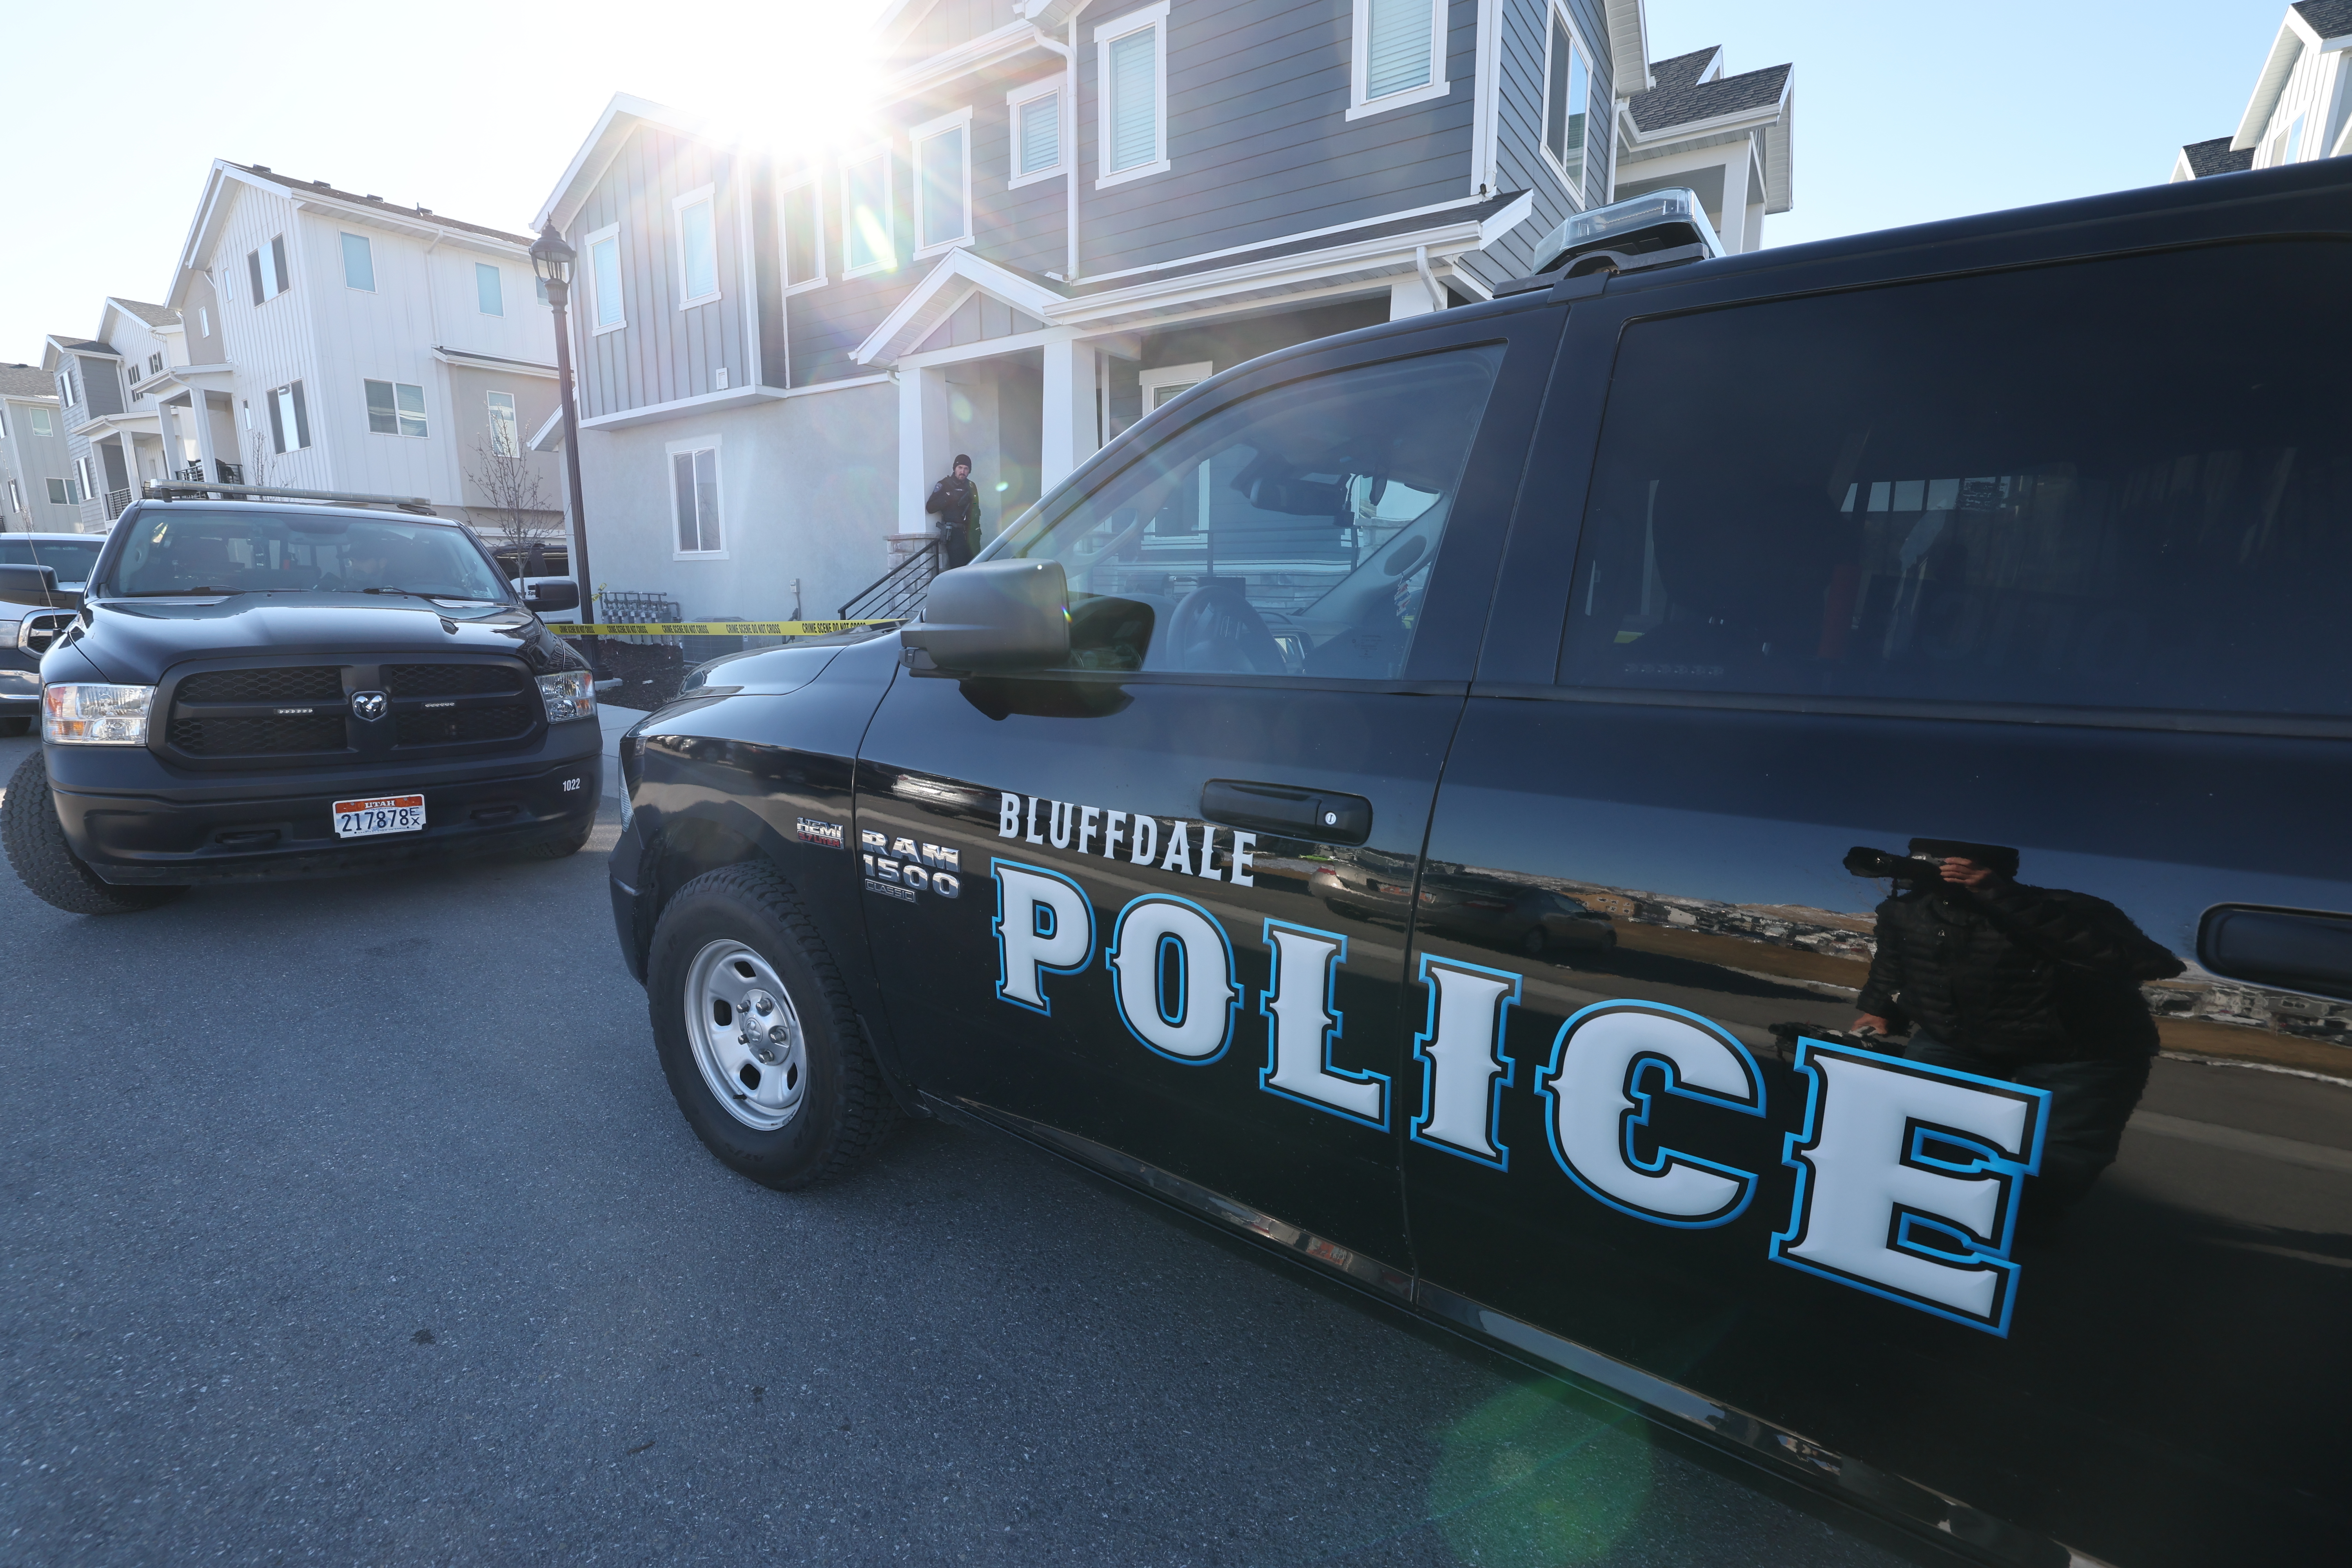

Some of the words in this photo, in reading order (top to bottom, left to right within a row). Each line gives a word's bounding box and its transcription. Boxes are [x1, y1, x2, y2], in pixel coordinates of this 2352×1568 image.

[662, 625, 674, 633] CRIME
[672, 625, 685, 633] SCENE
[683, 625, 690, 633] DO
[689, 625, 697, 633] NOT
[696, 625, 709, 633] CROSS
[726, 624, 739, 633] CRIME
[739, 624, 752, 633] SCENE
[751, 624, 758, 633] DO
[758, 624, 766, 633] NOT
[766, 624, 781, 633] CROSS
[802, 623, 817, 633] CRIME
[817, 623, 832, 633] SCENE
[833, 623, 839, 632] DO
[563, 778, 580, 792] 1022
[365, 800, 396, 809] UTAH
[341, 809, 409, 832] 217878
[797, 817, 843, 838] HEMI
[799, 832, 813, 841] 5.7
[814, 835, 840, 847] LITER
[998, 792, 1256, 887] BLUFFDALE
[862, 829, 960, 873] RAM
[863, 854, 960, 898] 1500
[867, 881, 913, 900] CLASSIC
[991, 857, 2053, 1337] POLICE
